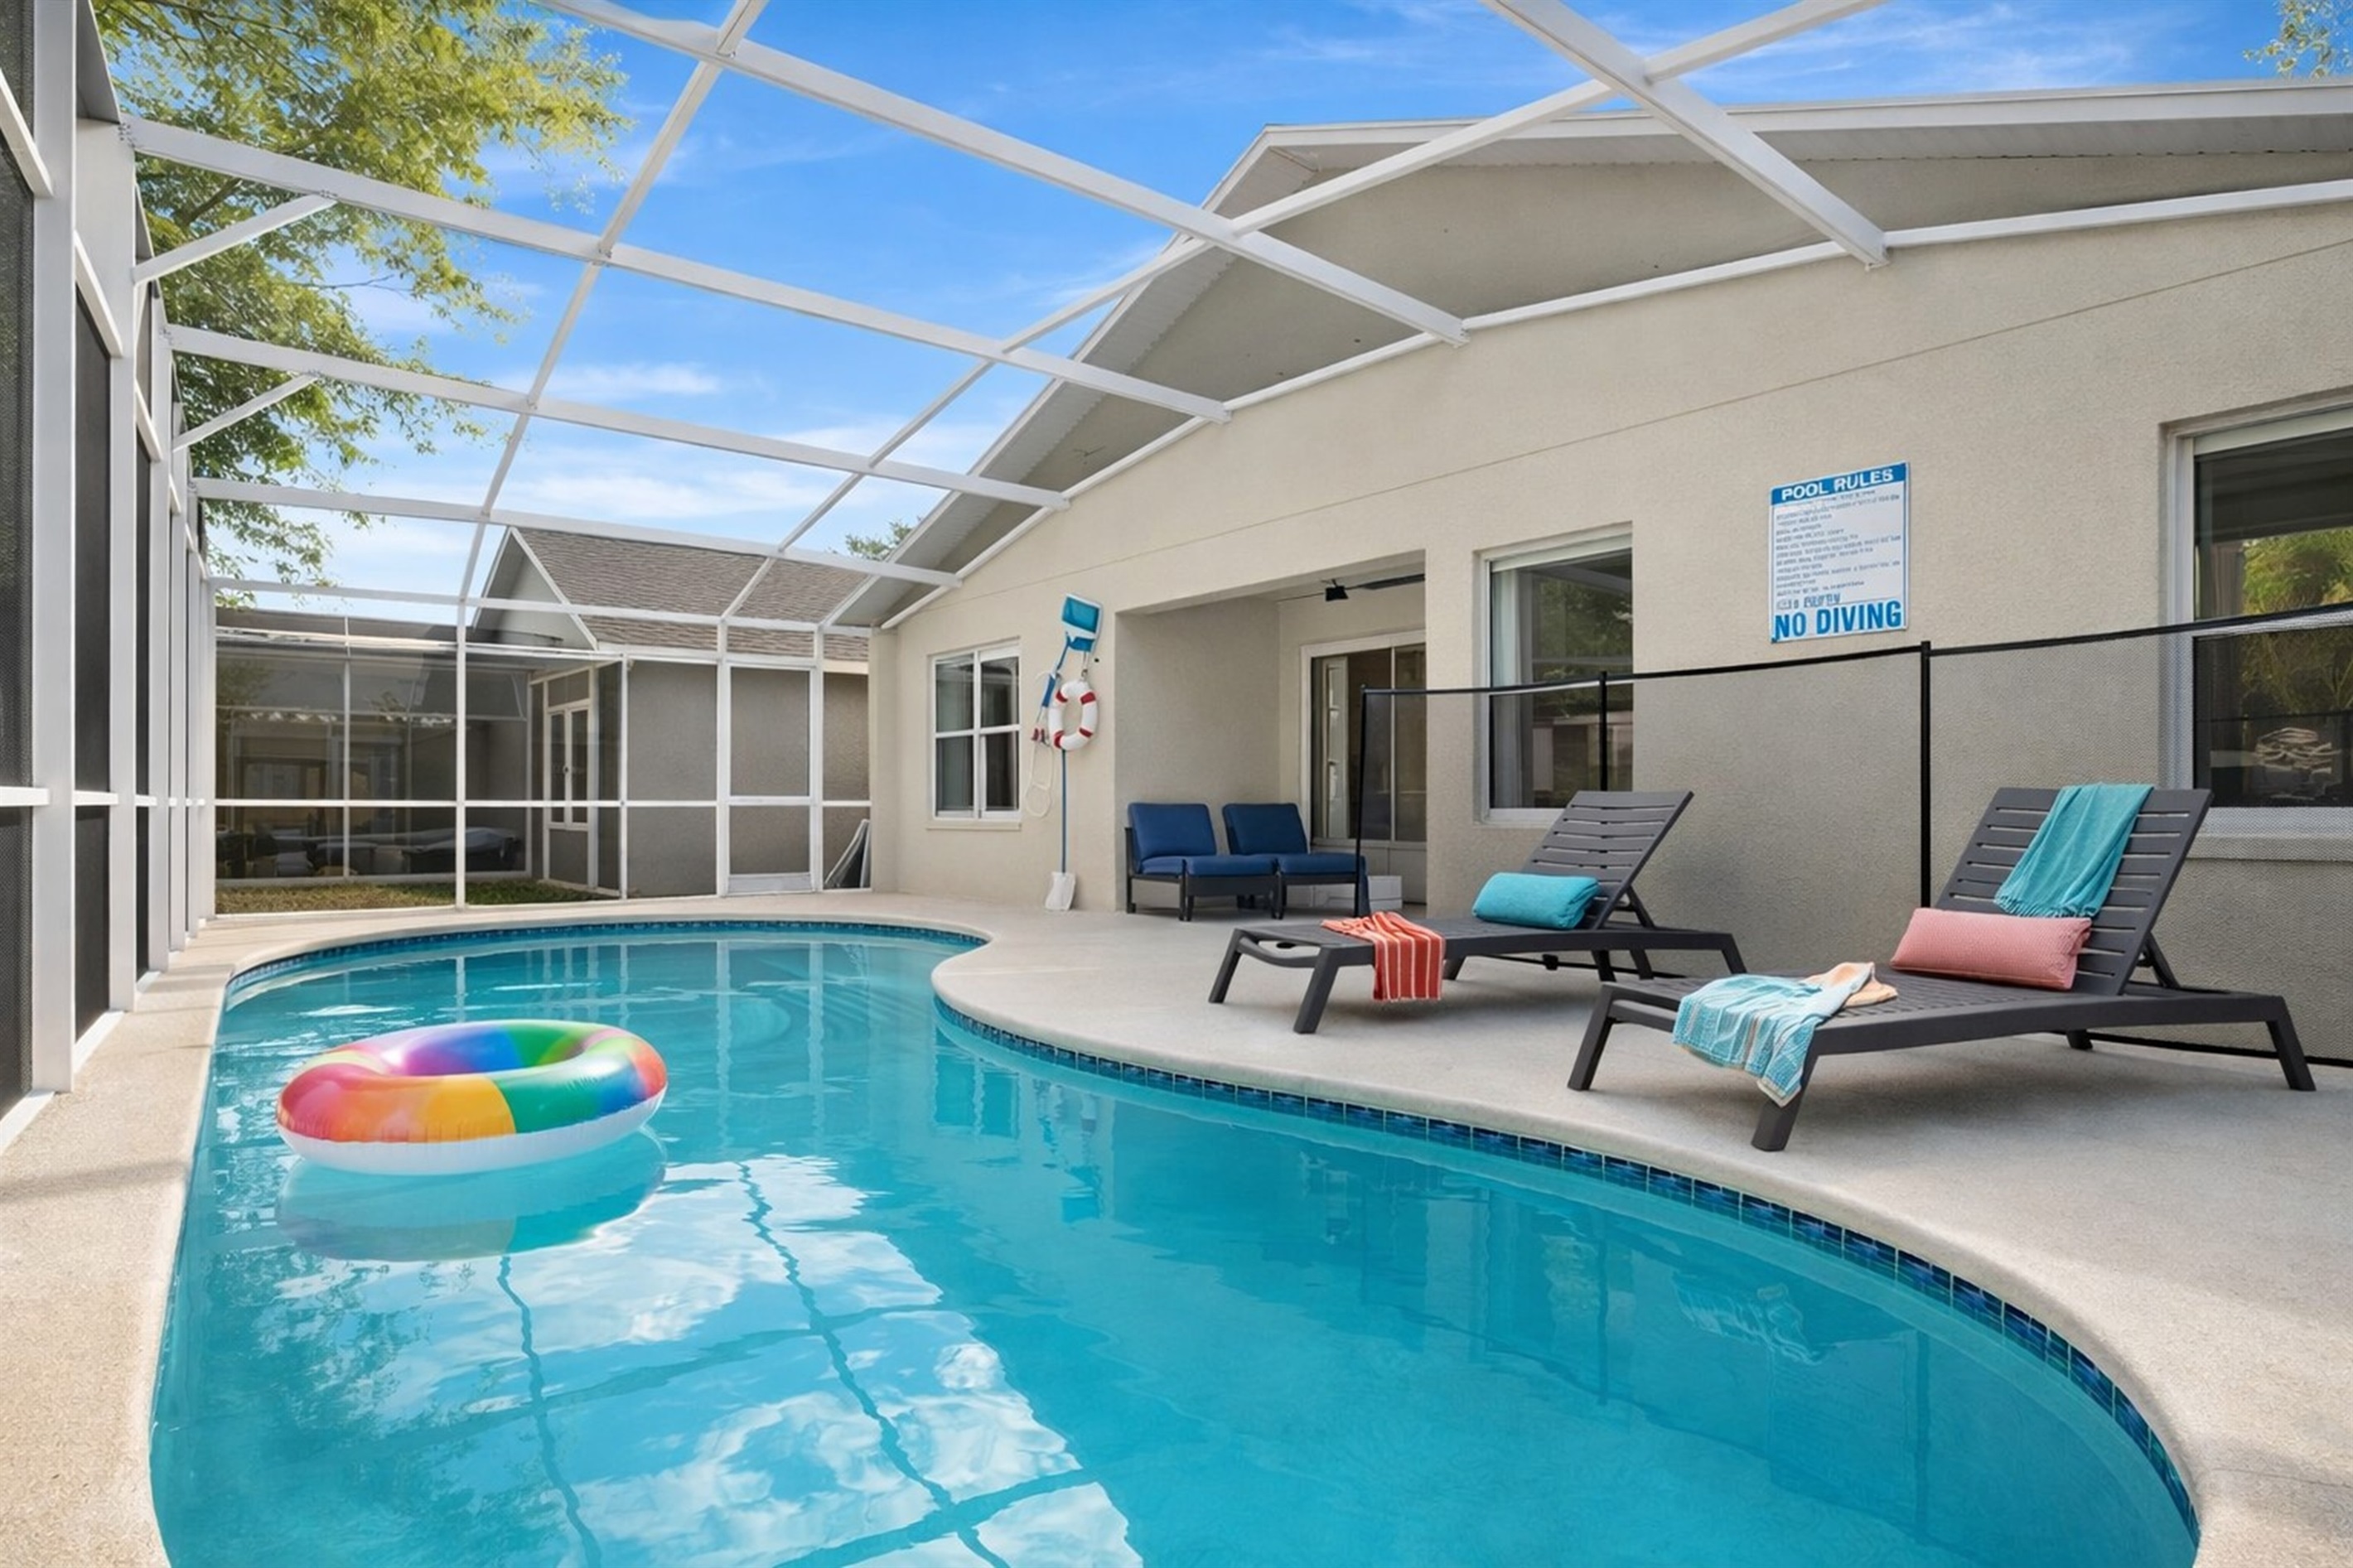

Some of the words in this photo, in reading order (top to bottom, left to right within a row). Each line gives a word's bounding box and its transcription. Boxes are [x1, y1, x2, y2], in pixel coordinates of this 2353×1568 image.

[1781, 482, 1829, 501] POOL
[1834, 469, 1894, 491] RULES
[1775, 611, 1806, 640] NO
[1817, 601, 1901, 634] DIVING
